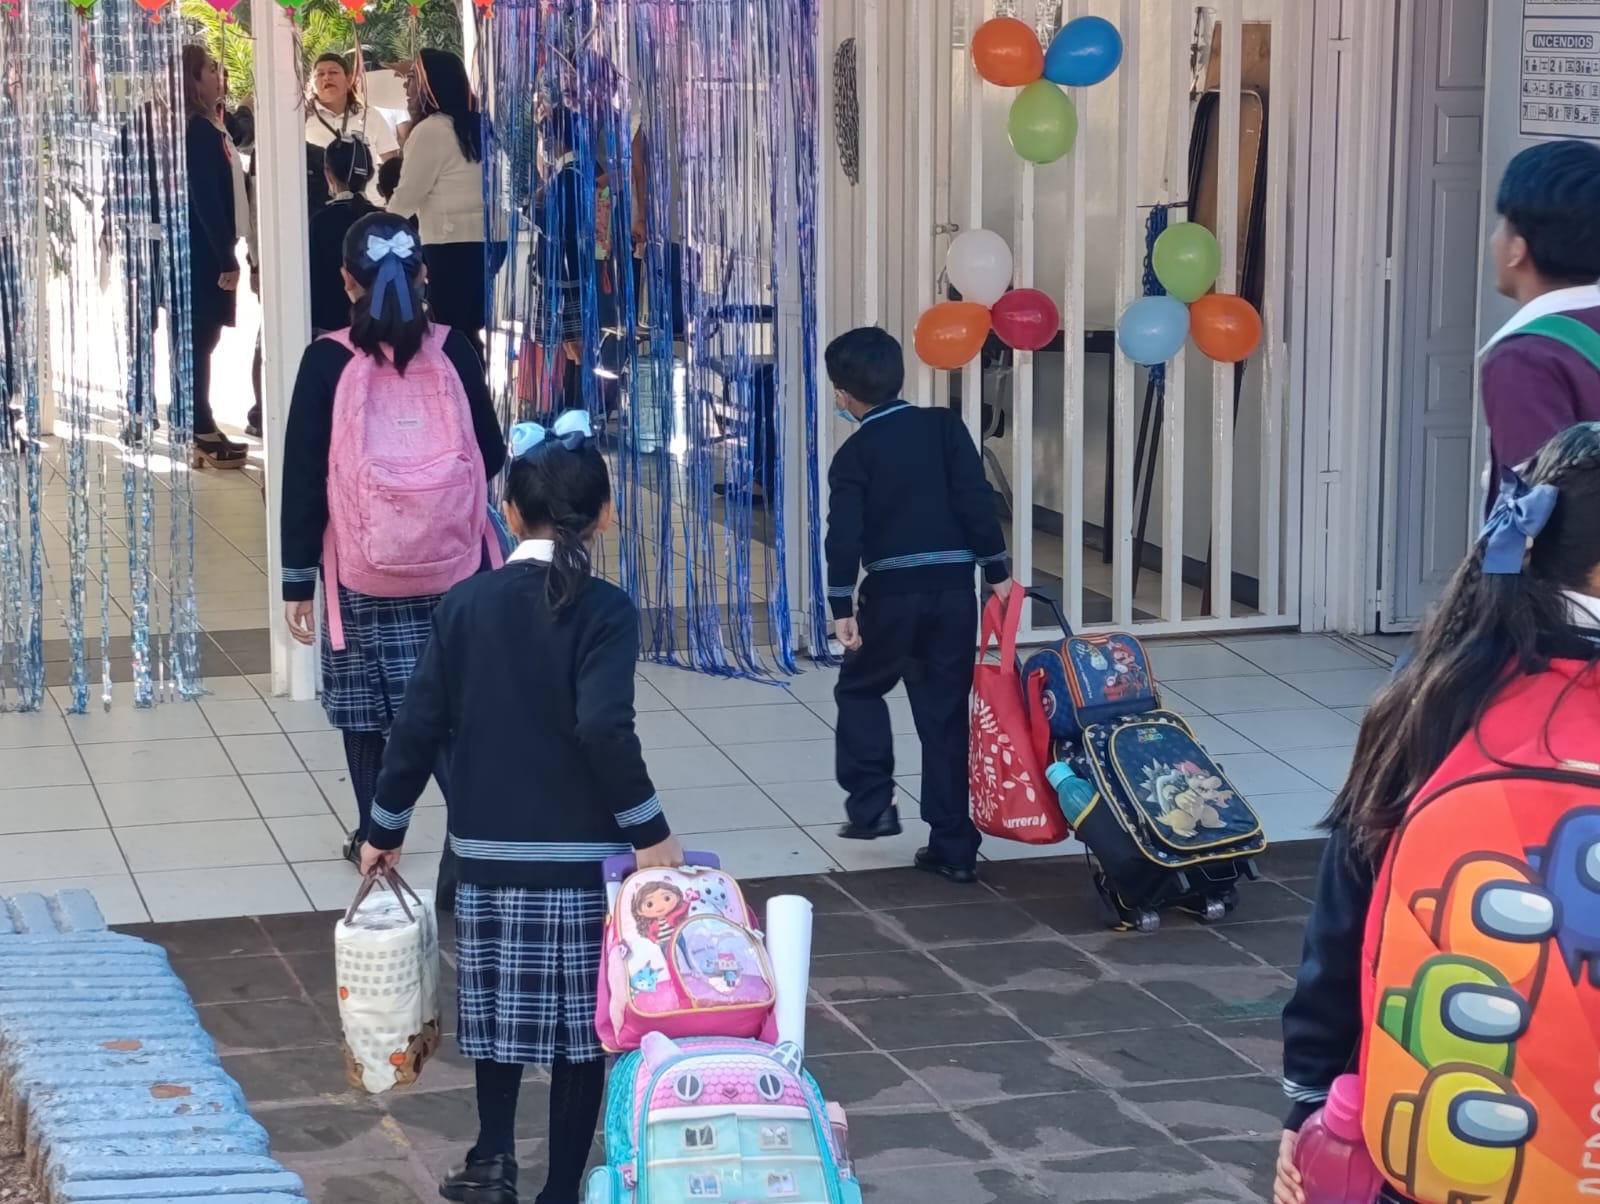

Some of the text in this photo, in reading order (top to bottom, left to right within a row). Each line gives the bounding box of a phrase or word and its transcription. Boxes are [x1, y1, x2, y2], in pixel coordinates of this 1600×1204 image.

[1534, 35, 1593, 49] INCENDIOS
[1550, 60, 1555, 72] 2
[1575, 61, 1581, 73] 3
[1523, 82, 1528, 93] 4
[1549, 83, 1554, 95] 5
[1575, 84, 1580, 96] 6
[1523, 105, 1528, 117] 7
[1548, 106, 1553, 118] 8
[1574, 107, 1580, 120] 9
